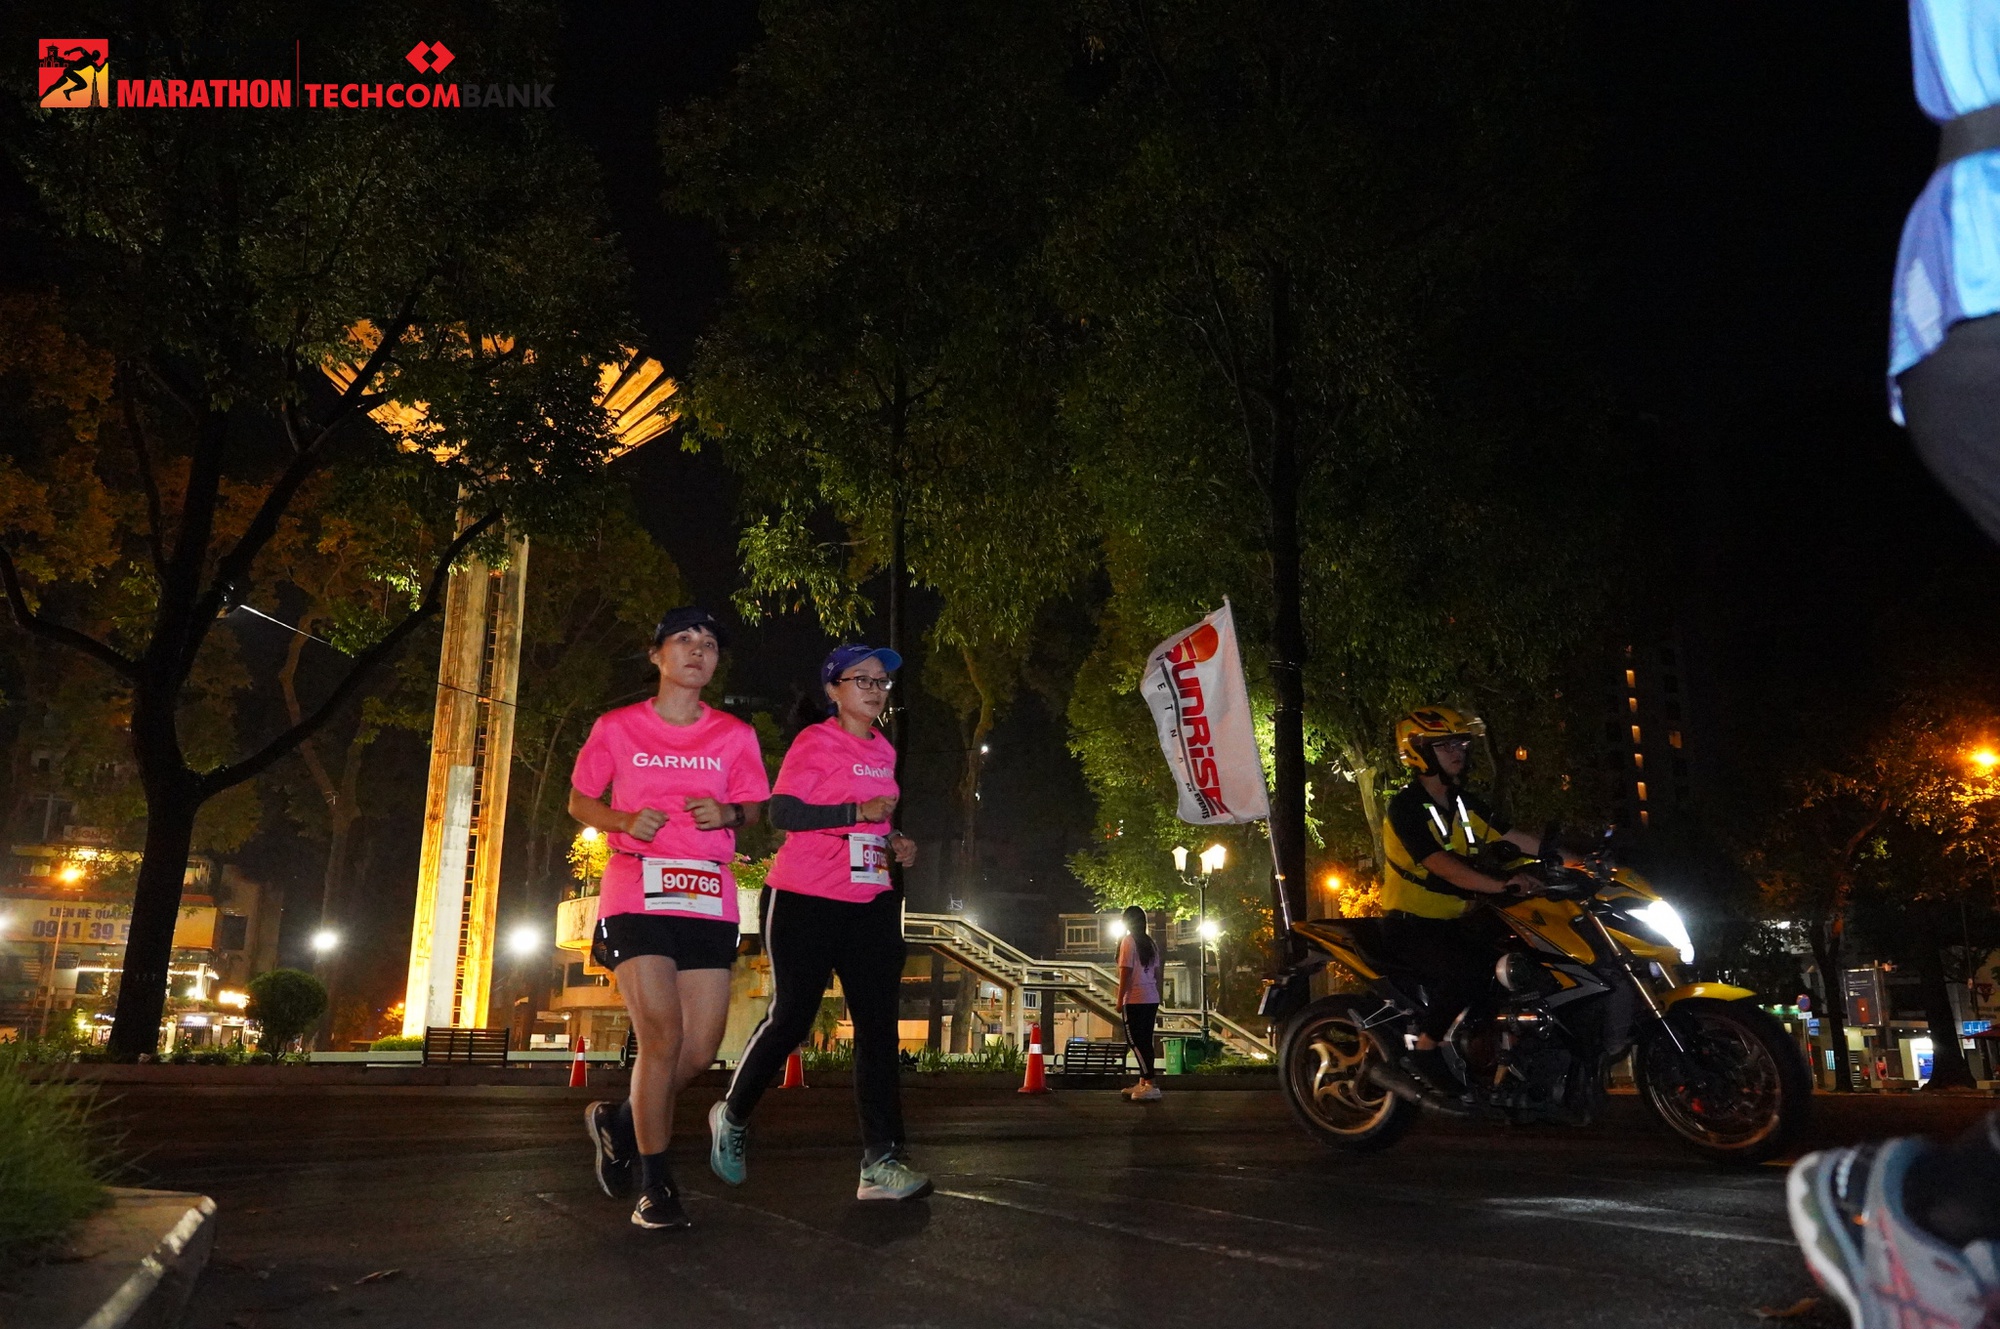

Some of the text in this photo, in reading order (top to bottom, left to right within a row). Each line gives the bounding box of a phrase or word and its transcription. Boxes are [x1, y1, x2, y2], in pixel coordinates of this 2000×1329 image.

[632, 752, 721, 771] GARMIN
[852, 763, 894, 779] GARM
[1194, 793, 1212, 819] EVENTS
[662, 873, 721, 895] 90766
[32, 920, 81, 939] 0911
[89, 922, 115, 940] 39
